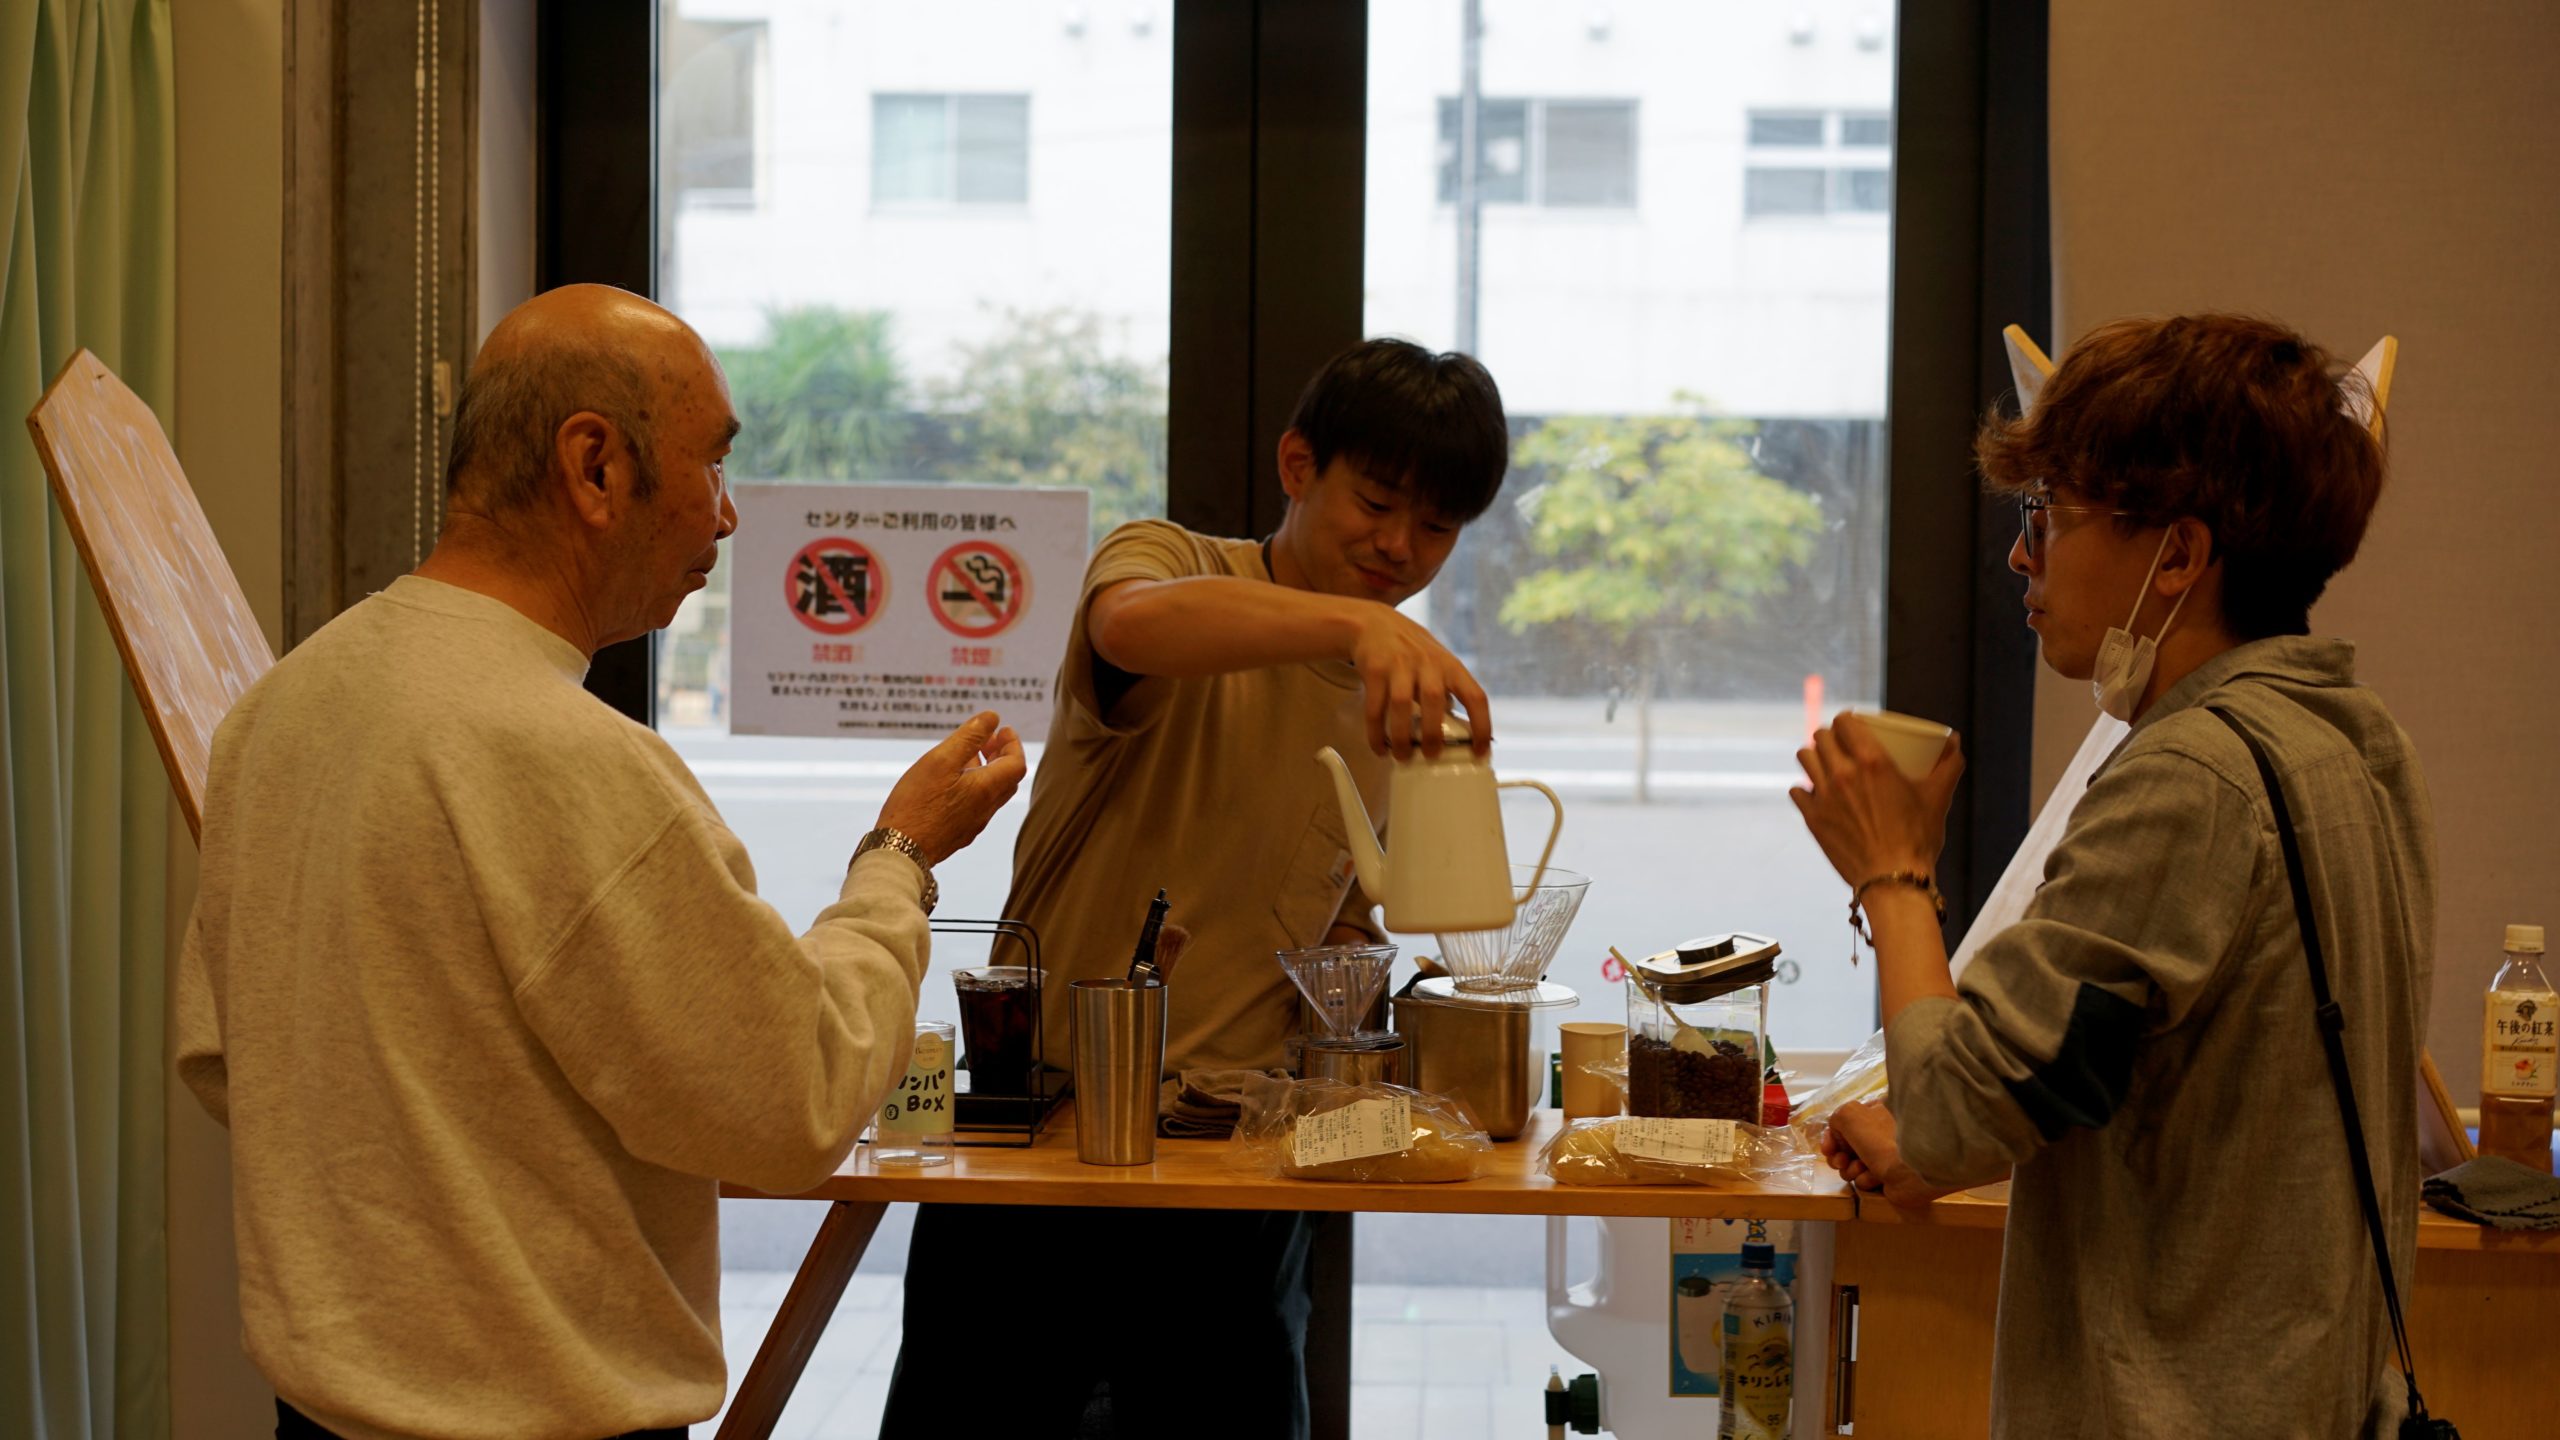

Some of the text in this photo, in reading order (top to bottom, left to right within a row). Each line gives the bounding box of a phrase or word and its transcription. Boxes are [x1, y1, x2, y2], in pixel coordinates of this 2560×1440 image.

[806, 511, 1017, 531] センターご利用の皆様へ
[2496, 1019, 2554, 1037] 午後の紅茶
[898, 1069, 946, 1092] ンパ
